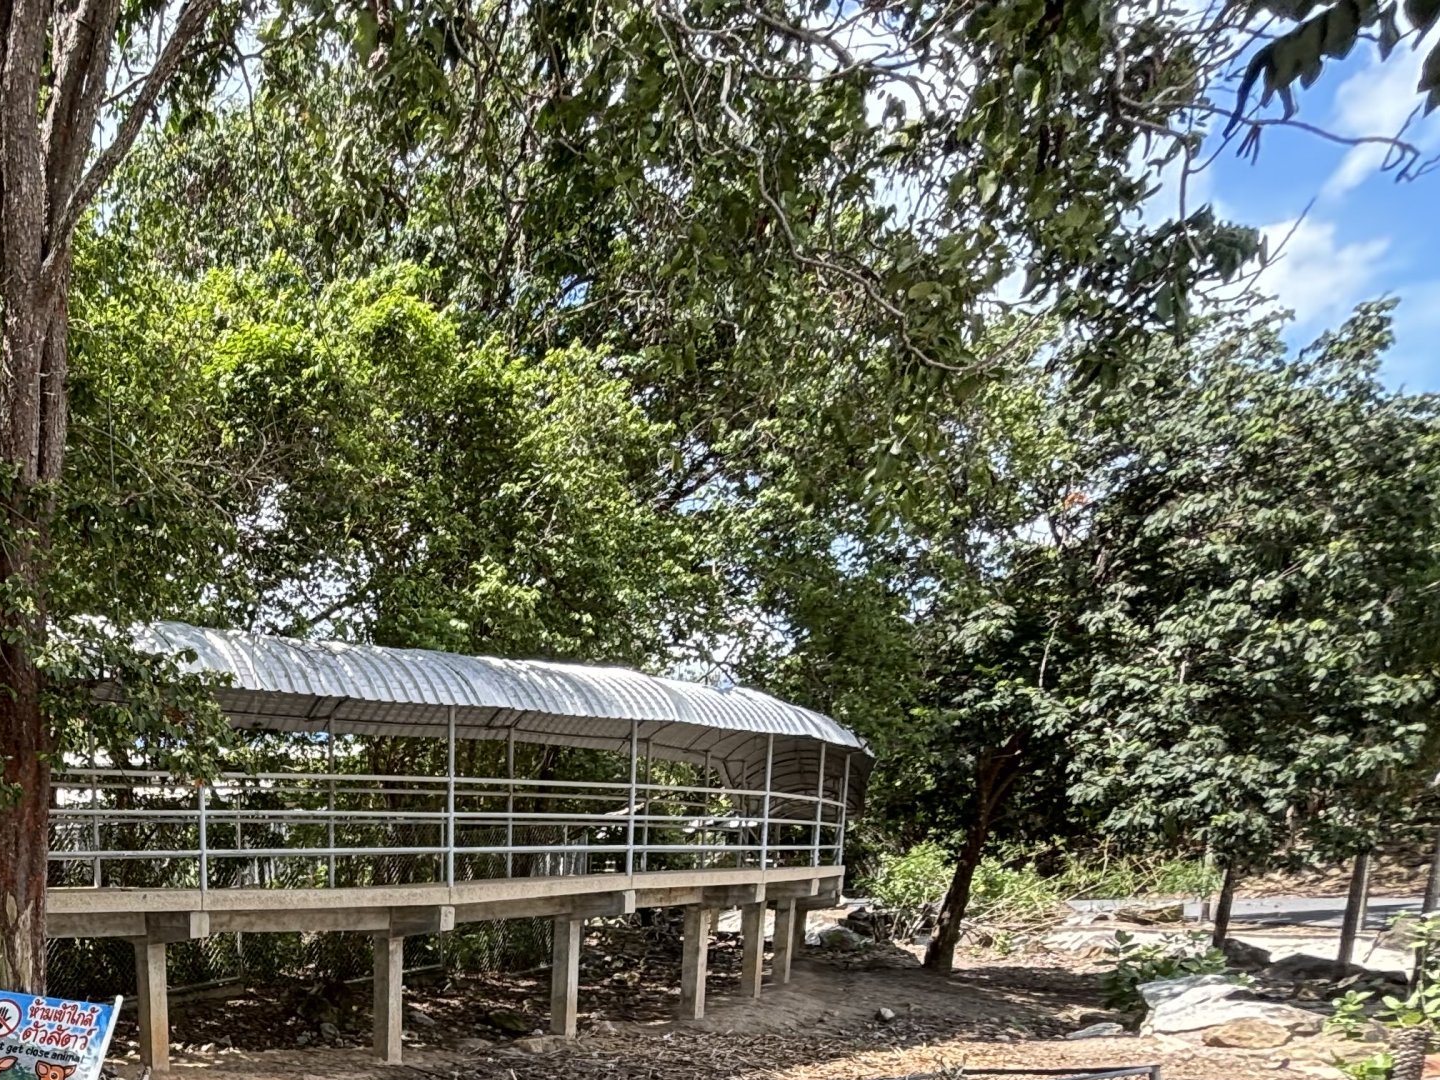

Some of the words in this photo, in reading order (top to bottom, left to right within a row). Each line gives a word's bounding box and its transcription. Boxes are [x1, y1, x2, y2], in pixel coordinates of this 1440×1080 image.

[29, 998, 100, 1027] ห้ามเข้าใกล้
[22, 1020, 98, 1051] ตัวสัตว์
[5, 1044, 24, 1055] get
[25, 1047, 50, 1058] close
[50, 1050, 86, 1064] animal
